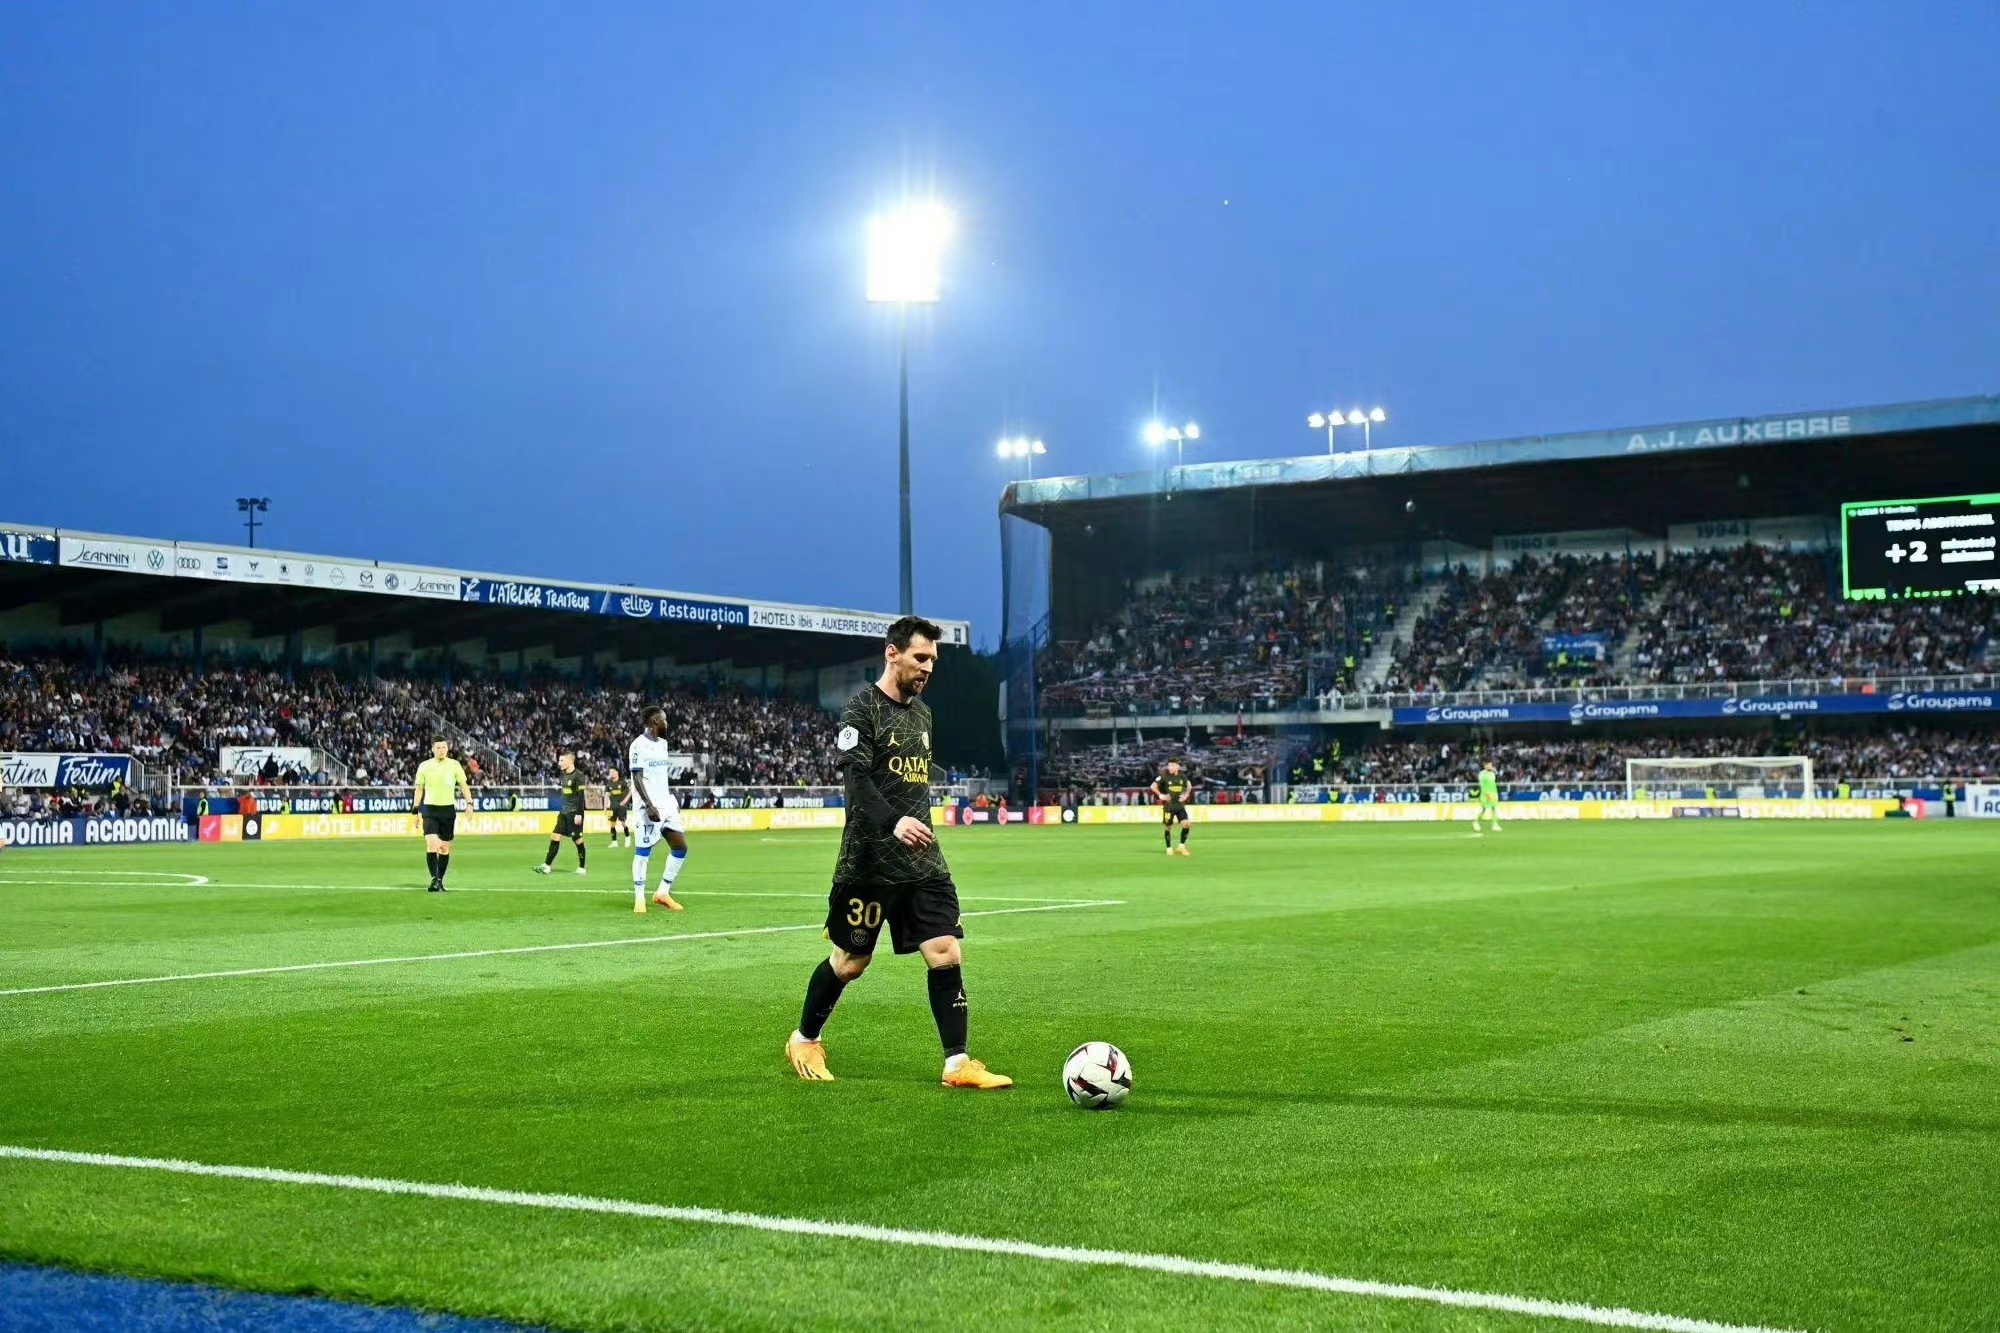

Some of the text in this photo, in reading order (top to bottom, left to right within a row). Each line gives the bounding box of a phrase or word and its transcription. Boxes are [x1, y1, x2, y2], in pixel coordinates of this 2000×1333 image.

[1626, 415, 1850, 451] A.J. AUXERRE
[489, 582, 541, 607] L'ATELIER
[546, 590, 590, 611] TRAITEUR
[659, 600, 744, 624] Restauration
[753, 612, 759, 623] 2
[761, 612, 795, 626] HOTELS
[821, 618, 859, 632] AUXERRE
[1585, 703, 1659, 717] Groupama
[1739, 699, 1818, 713] Groupama
[1906, 694, 1992, 710] Groupama
[1441, 707, 1509, 721] Groupama
[846, 897, 882, 929] 30
